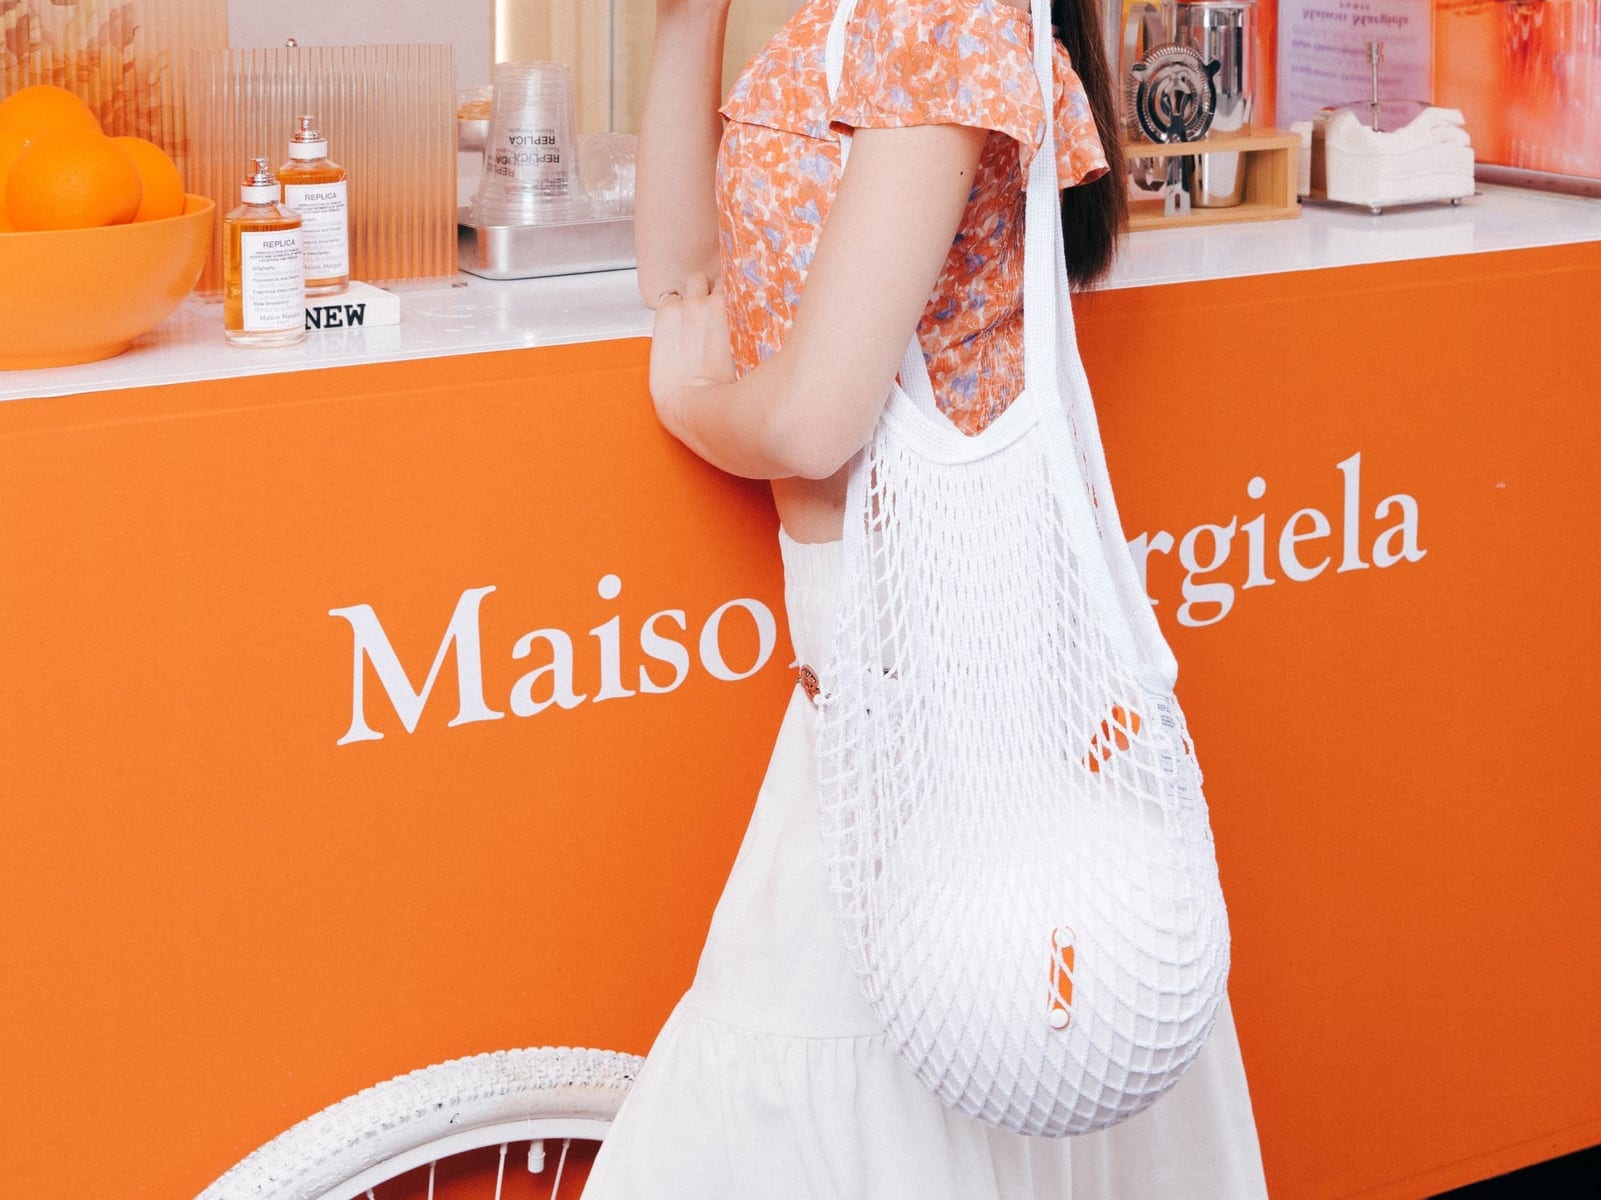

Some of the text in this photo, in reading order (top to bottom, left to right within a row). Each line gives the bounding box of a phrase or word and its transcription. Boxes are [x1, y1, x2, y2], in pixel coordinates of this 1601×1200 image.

[509, 136, 556, 146] REPLICA
[304, 192, 337, 201] REPLICA
[263, 239, 296, 249] REPLICA
[305, 303, 366, 330] NEW
[1126, 451, 1427, 628] rgiela
[328, 574, 800, 746] Maiso
